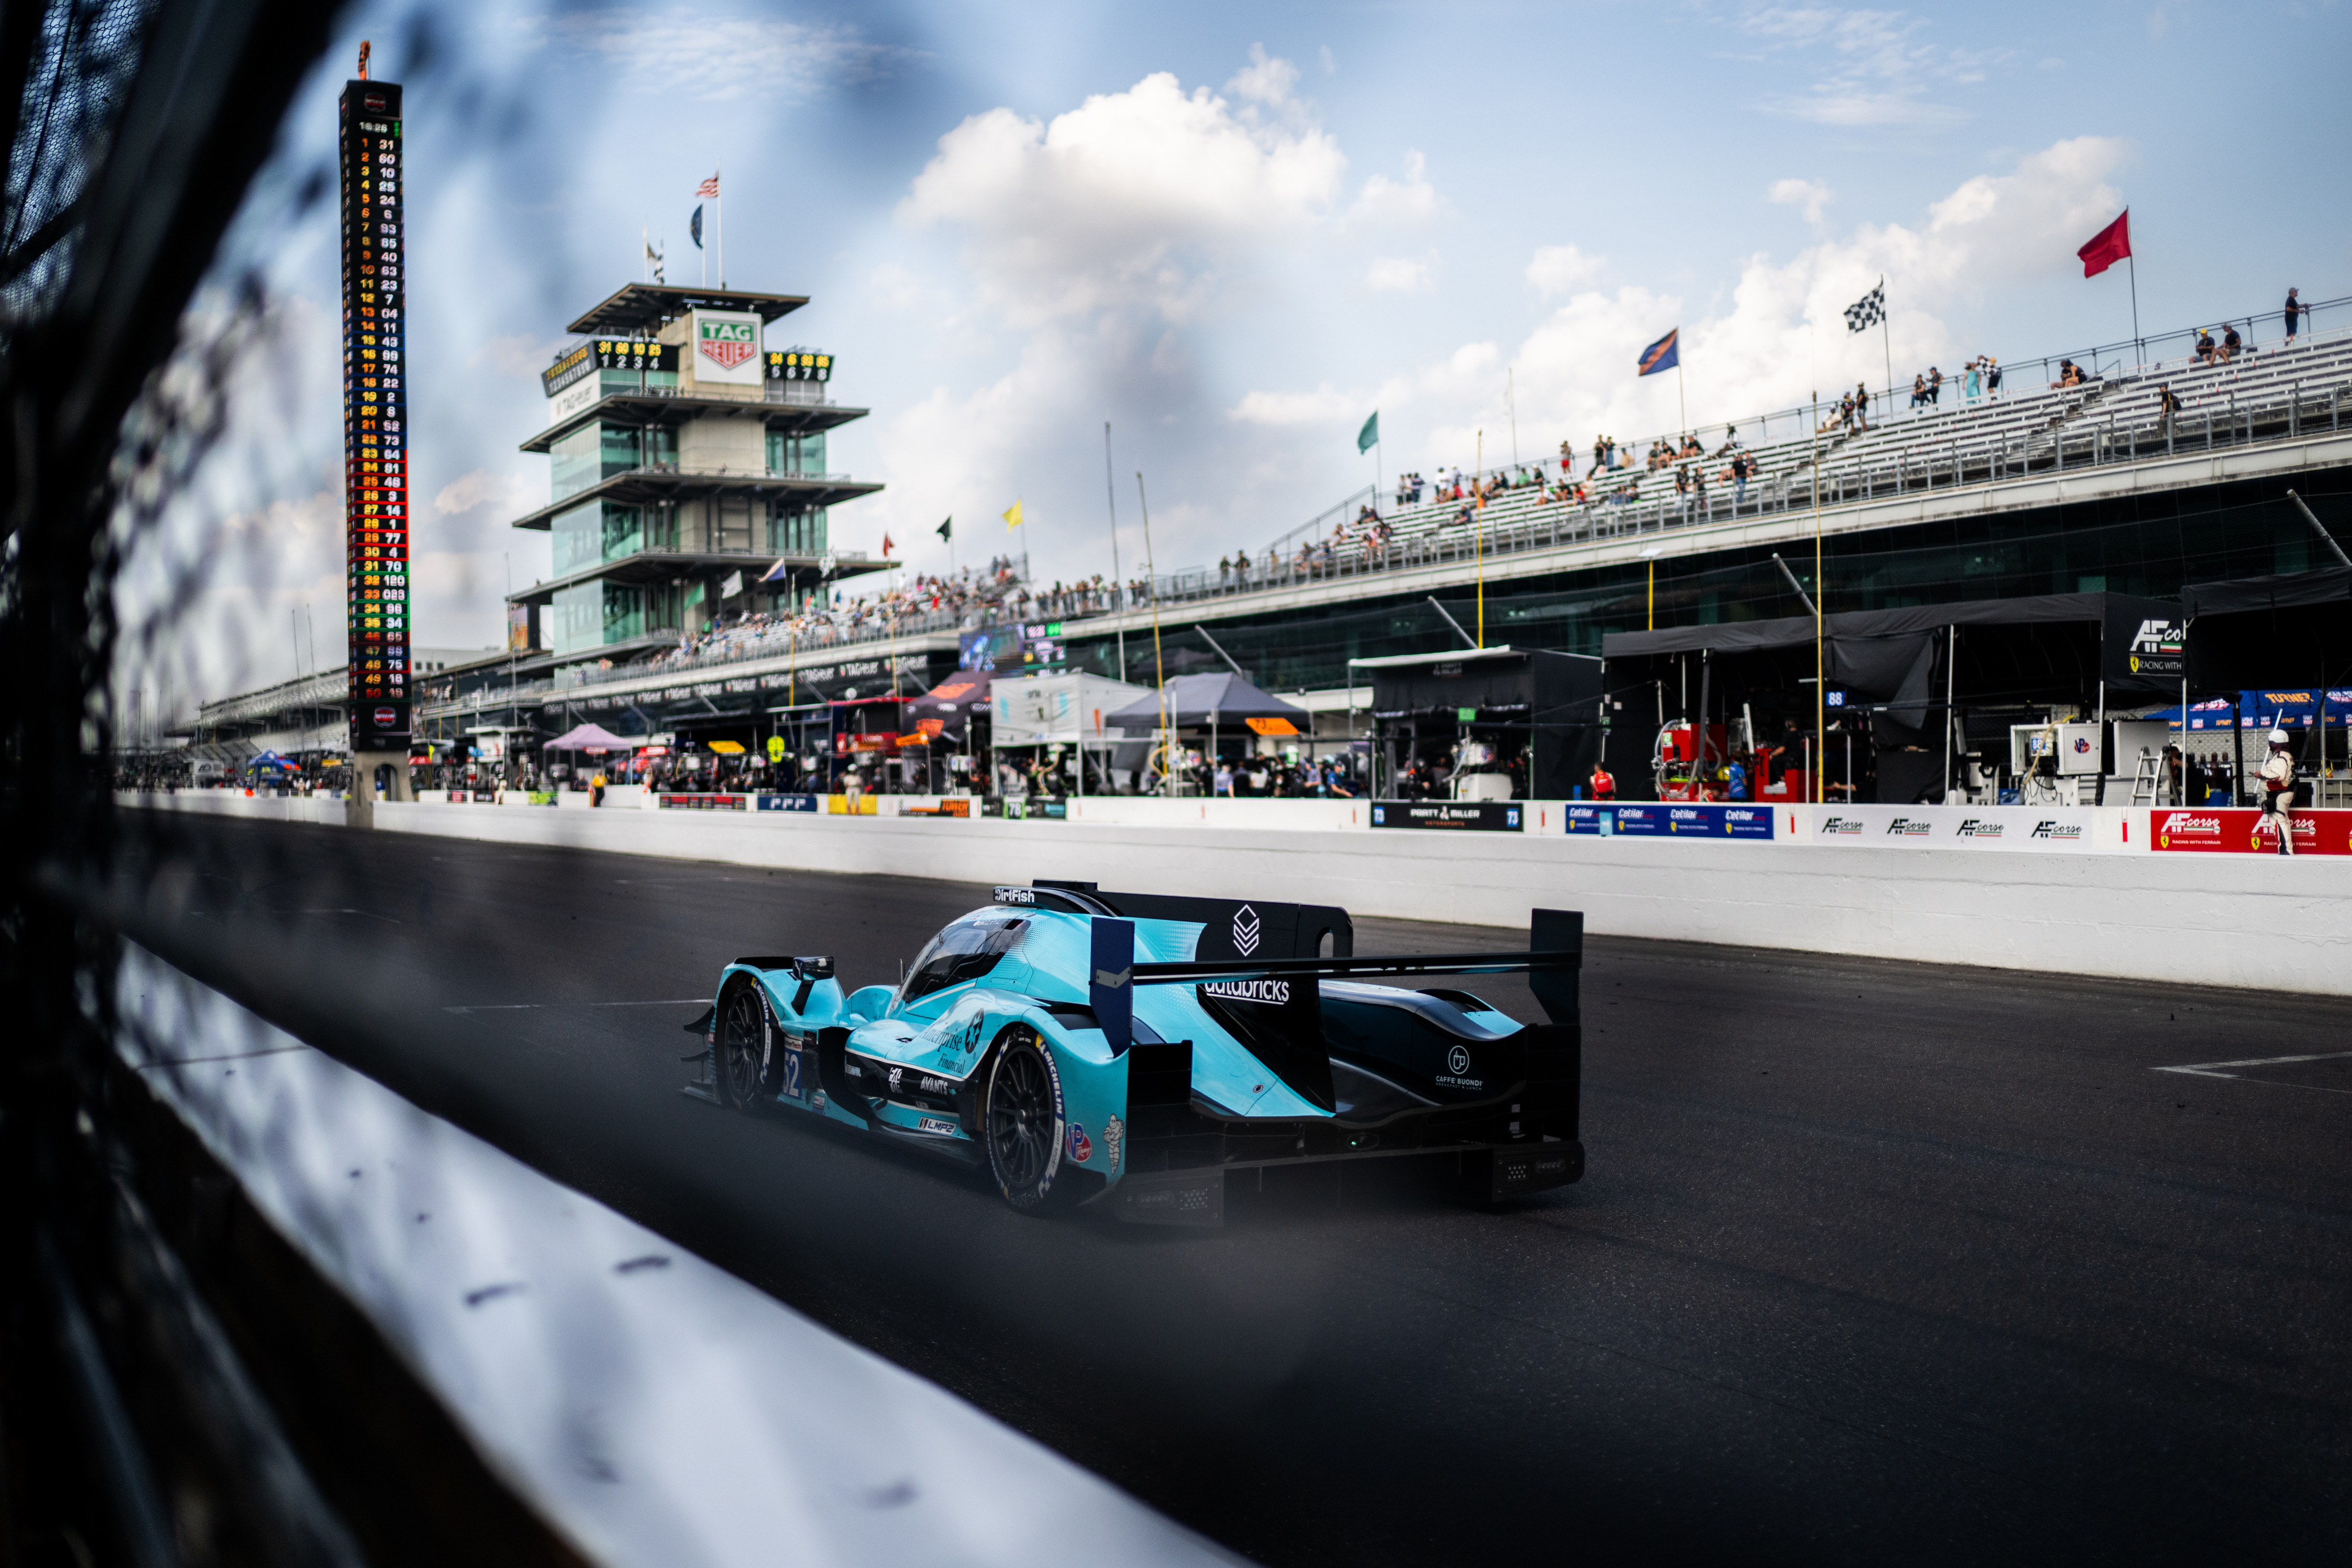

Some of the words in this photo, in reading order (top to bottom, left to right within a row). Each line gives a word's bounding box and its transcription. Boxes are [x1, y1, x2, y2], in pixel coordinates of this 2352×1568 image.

[359, 121, 388, 133] 16:26
[362, 138, 367, 147] 1
[379, 140, 394, 151] 31
[361, 152, 369, 162] 2
[379, 153, 395, 165] 60
[361, 166, 369, 176] 3
[380, 167, 395, 178] 10
[361, 180, 370, 190] 4
[379, 181, 396, 192] 25
[362, 193, 370, 203] 5
[379, 195, 396, 205] 24
[362, 207, 370, 218] 6
[384, 209, 392, 220] 6
[362, 222, 370, 232] 7
[381, 223, 396, 235] 93
[362, 236, 370, 246] 8
[381, 237, 397, 249] 85
[363, 250, 371, 259] 9
[381, 252, 397, 263] 40
[360, 264, 374, 274] 10
[382, 266, 397, 276] 63
[360, 279, 373, 289] 11
[381, 280, 397, 291] 23
[360, 293, 375, 303] 12
[385, 294, 393, 305] 7
[361, 307, 375, 317] 13
[381, 308, 398, 319] 04
[361, 321, 375, 331] 14
[383, 322, 396, 333] 11
[704, 323, 751, 340] TAG
[361, 335, 375, 345] 15
[361, 349, 376, 360] 16
[598, 341, 612, 354] 31
[615, 342, 629, 354] 60
[633, 343, 645, 355] 10
[648, 344, 661, 356] 25
[703, 341, 754, 365] HEUER
[602, 354, 609, 367] 1
[617, 355, 627, 368] 2
[633, 356, 642, 370] 3
[650, 357, 659, 370] 4
[770, 352, 783, 365] 24
[362, 363, 376, 373] 17
[383, 363, 398, 375] 74
[771, 365, 780, 378] 5
[787, 366, 796, 379] 6
[802, 367, 812, 379] 7
[817, 368, 827, 381] 8
[362, 377, 376, 388] 18
[383, 377, 399, 388] 22
[362, 391, 377, 402] 19
[387, 392, 395, 403] 2
[361, 405, 377, 416] 20
[362, 419, 376, 430] 21
[362, 434, 377, 444] 22
[384, 435, 399, 446] 73
[362, 447, 378, 459] 23
[362, 462, 378, 472] 24
[363, 476, 378, 488] 25
[386, 504, 400, 517] 14
[389, 518, 396, 530] 1
[385, 532, 401, 545] 77
[389, 547, 398, 558] 4
[386, 560, 402, 572] 70
[384, 574, 405, 586] 120
[386, 617, 402, 629] 34
[2130, 620, 2170, 653] AF
[388, 660, 402, 671] 75
[2139, 661, 2164, 670] RACING
[2165, 661, 2182, 670] WITH
[389, 674, 403, 685] 18
[1828, 692, 1842, 706] 88
[2265, 693, 2314, 704] TURNER
[1664, 735, 1671, 743] 47
[1374, 809, 1385, 823] 73
[1411, 809, 1439, 818] PRATT
[1450, 809, 1481, 818] MILLER
[1507, 811, 1519, 825] 73
[1570, 808, 1593, 818] Cetilar
[1619, 809, 1644, 819] Cetilar
[1670, 809, 1698, 820] Cetilar
[1725, 810, 1754, 821] Cetilar
[2161, 813, 2192, 833] AF
[2186, 818, 2220, 826] corse
[2289, 818, 2316, 827] orse
[995, 889, 1035, 903] DirtFish
[756, 985, 769, 1020] MICHELIN
[919, 1027, 963, 1052] Ameriprise
[938, 1053, 966, 1075] Financial
[783, 1052, 799, 1097] 52
[920, 1076, 949, 1095] AVANTS
[1044, 1051, 1063, 1114] MICHELIN
[927, 1121, 955, 1133] LMP2
[1067, 1123, 1085, 1160] VP
[1050, 1148, 1060, 1170] SPORT
